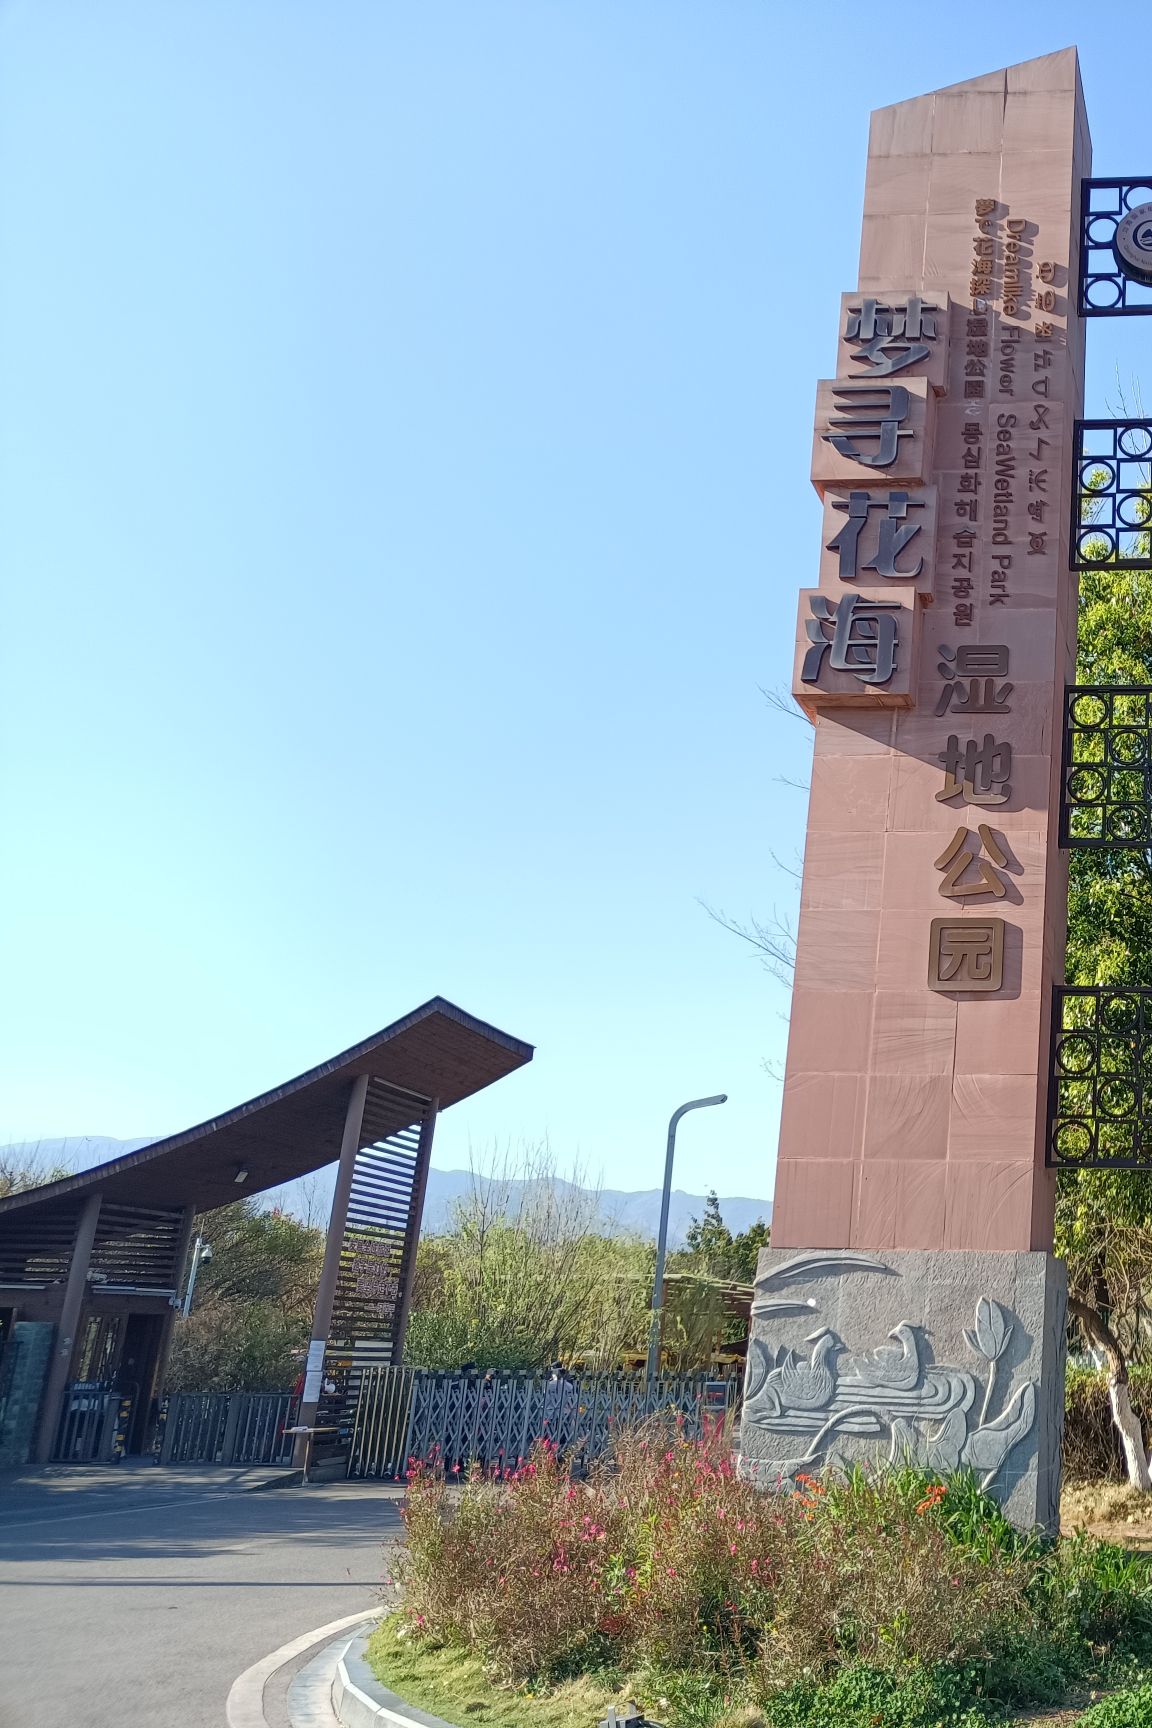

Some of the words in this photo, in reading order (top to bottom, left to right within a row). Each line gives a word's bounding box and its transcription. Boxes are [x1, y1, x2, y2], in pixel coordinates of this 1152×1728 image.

[1003, 218, 1026, 316] Dreamlike
[998, 326, 1021, 397] Flower
[801, 297, 938, 686] 梦寻花海
[989, 554, 1013, 606] Park
[928, 643, 1015, 992] 湿地公园
